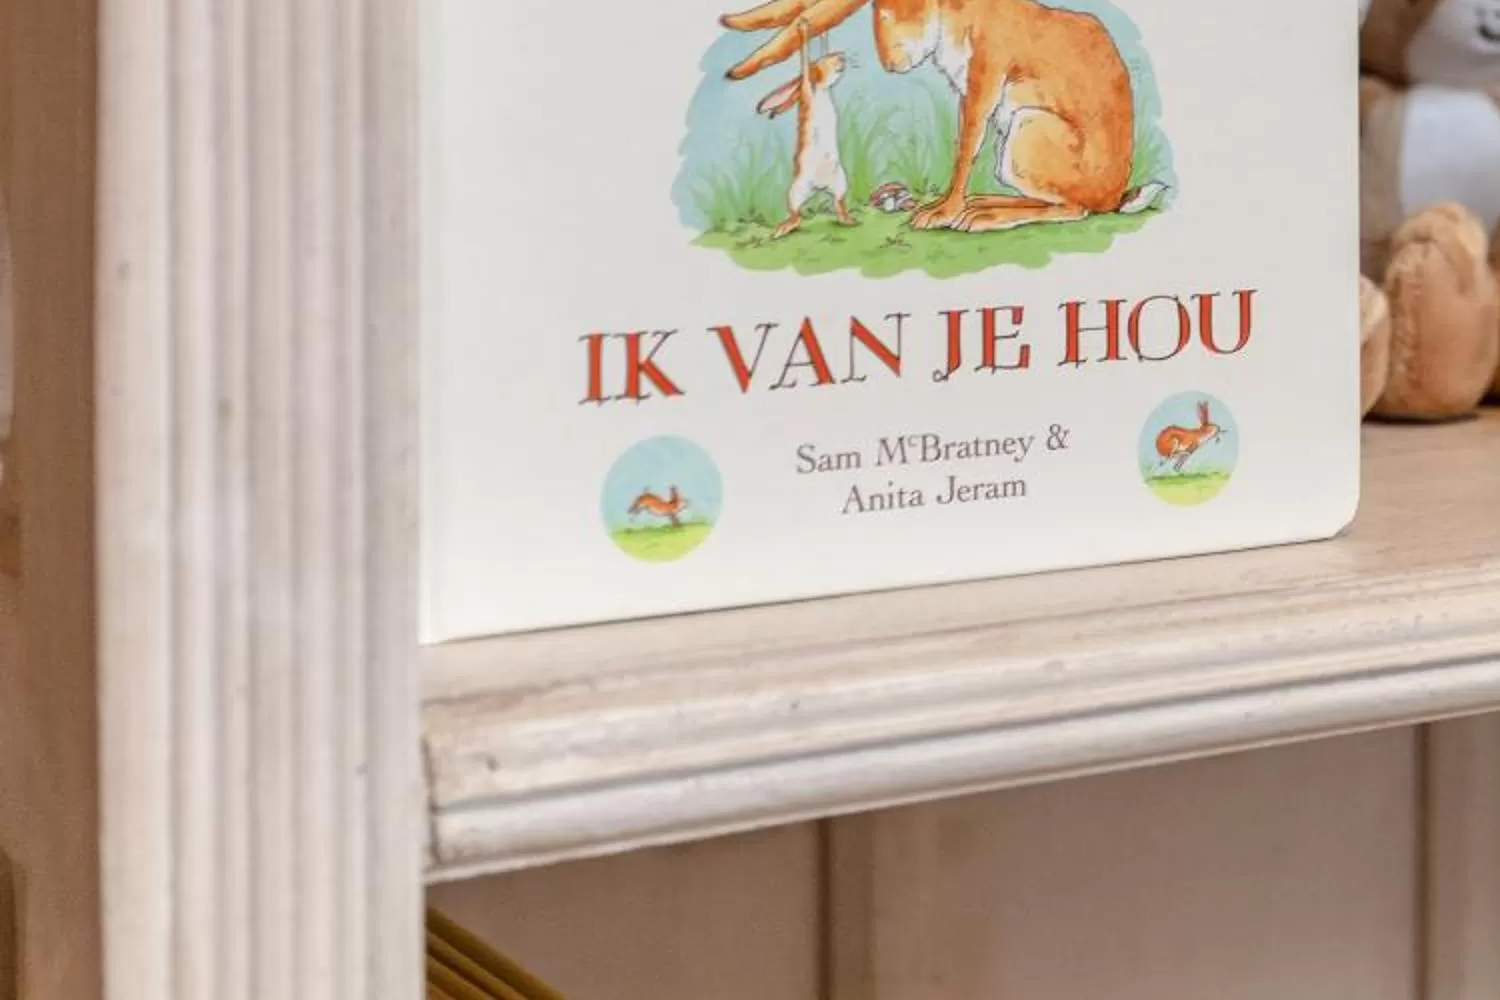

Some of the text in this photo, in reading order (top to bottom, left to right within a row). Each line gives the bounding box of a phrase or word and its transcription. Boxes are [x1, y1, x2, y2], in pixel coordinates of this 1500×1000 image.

[578, 288, 1259, 407] IK VAN JE HOU
[795, 423, 1070, 474] Sam McBratney &
[841, 475, 1027, 514] Anita Jeram
